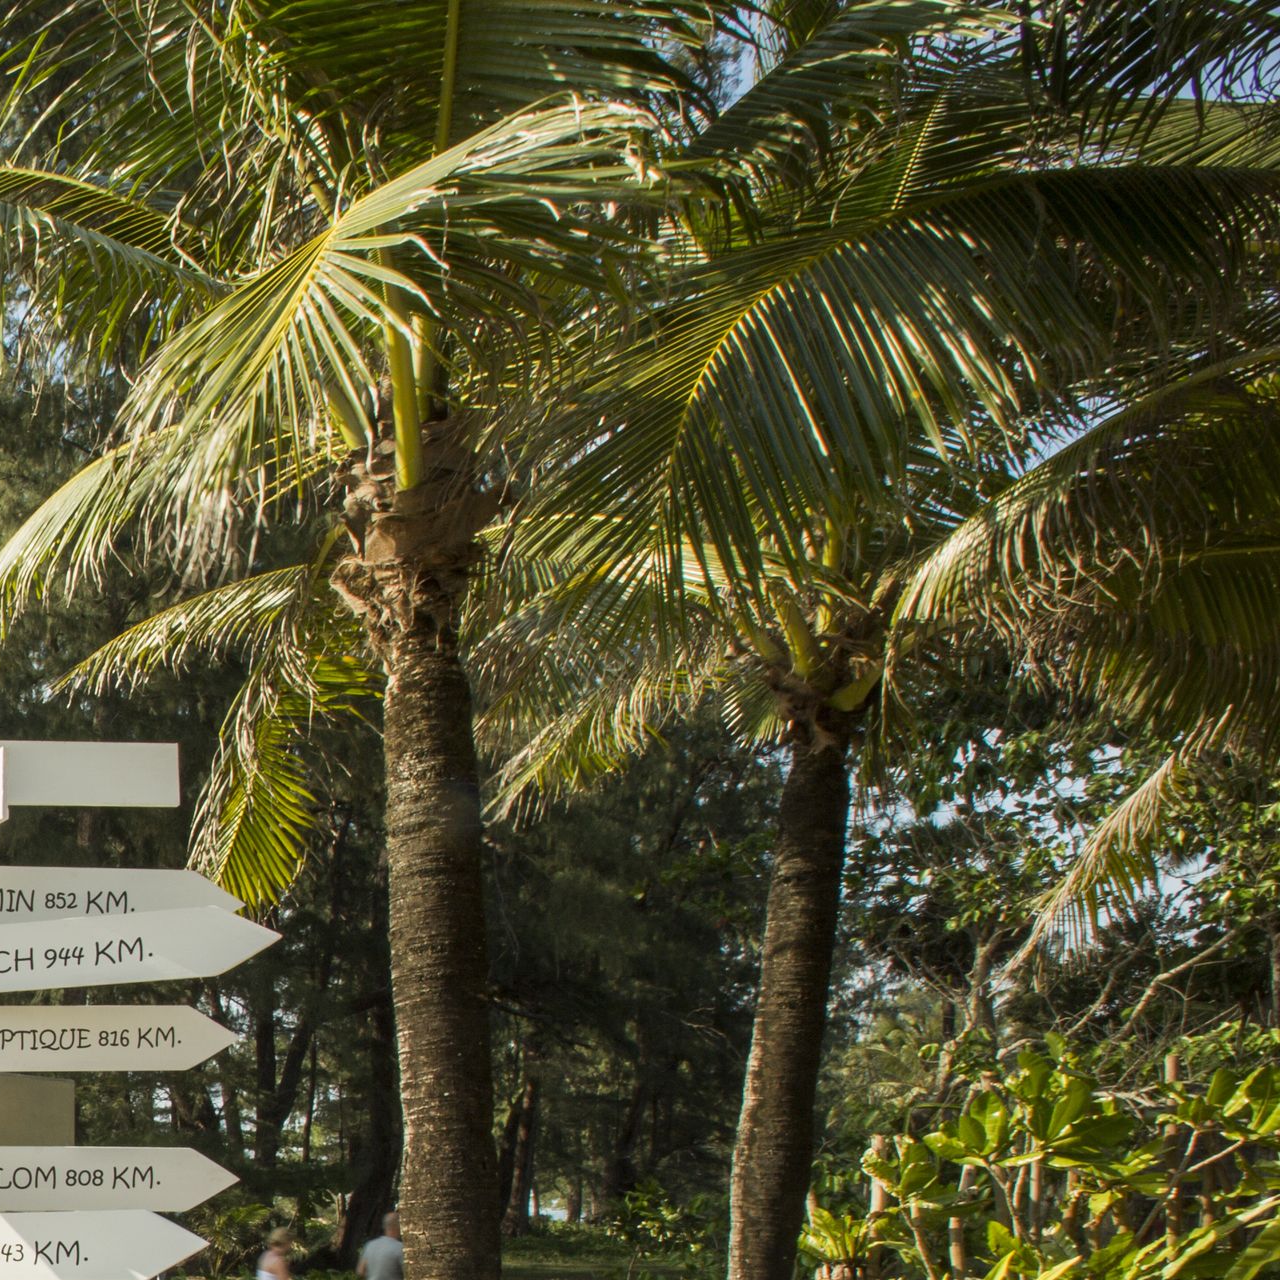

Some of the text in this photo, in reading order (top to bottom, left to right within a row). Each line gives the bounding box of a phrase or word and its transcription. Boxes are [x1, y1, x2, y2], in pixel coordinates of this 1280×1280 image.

[45, 892, 78, 909] 852
[85, 891, 135, 914] KM.
[44, 946, 85, 968] 944
[95, 937, 153, 966] KM.
[98, 1029, 130, 1047] 816
[137, 1026, 181, 1048] KM.
[65, 1169, 104, 1187] 808
[112, 1166, 160, 1190] KM.
[34, 1240, 88, 1266] KM.
